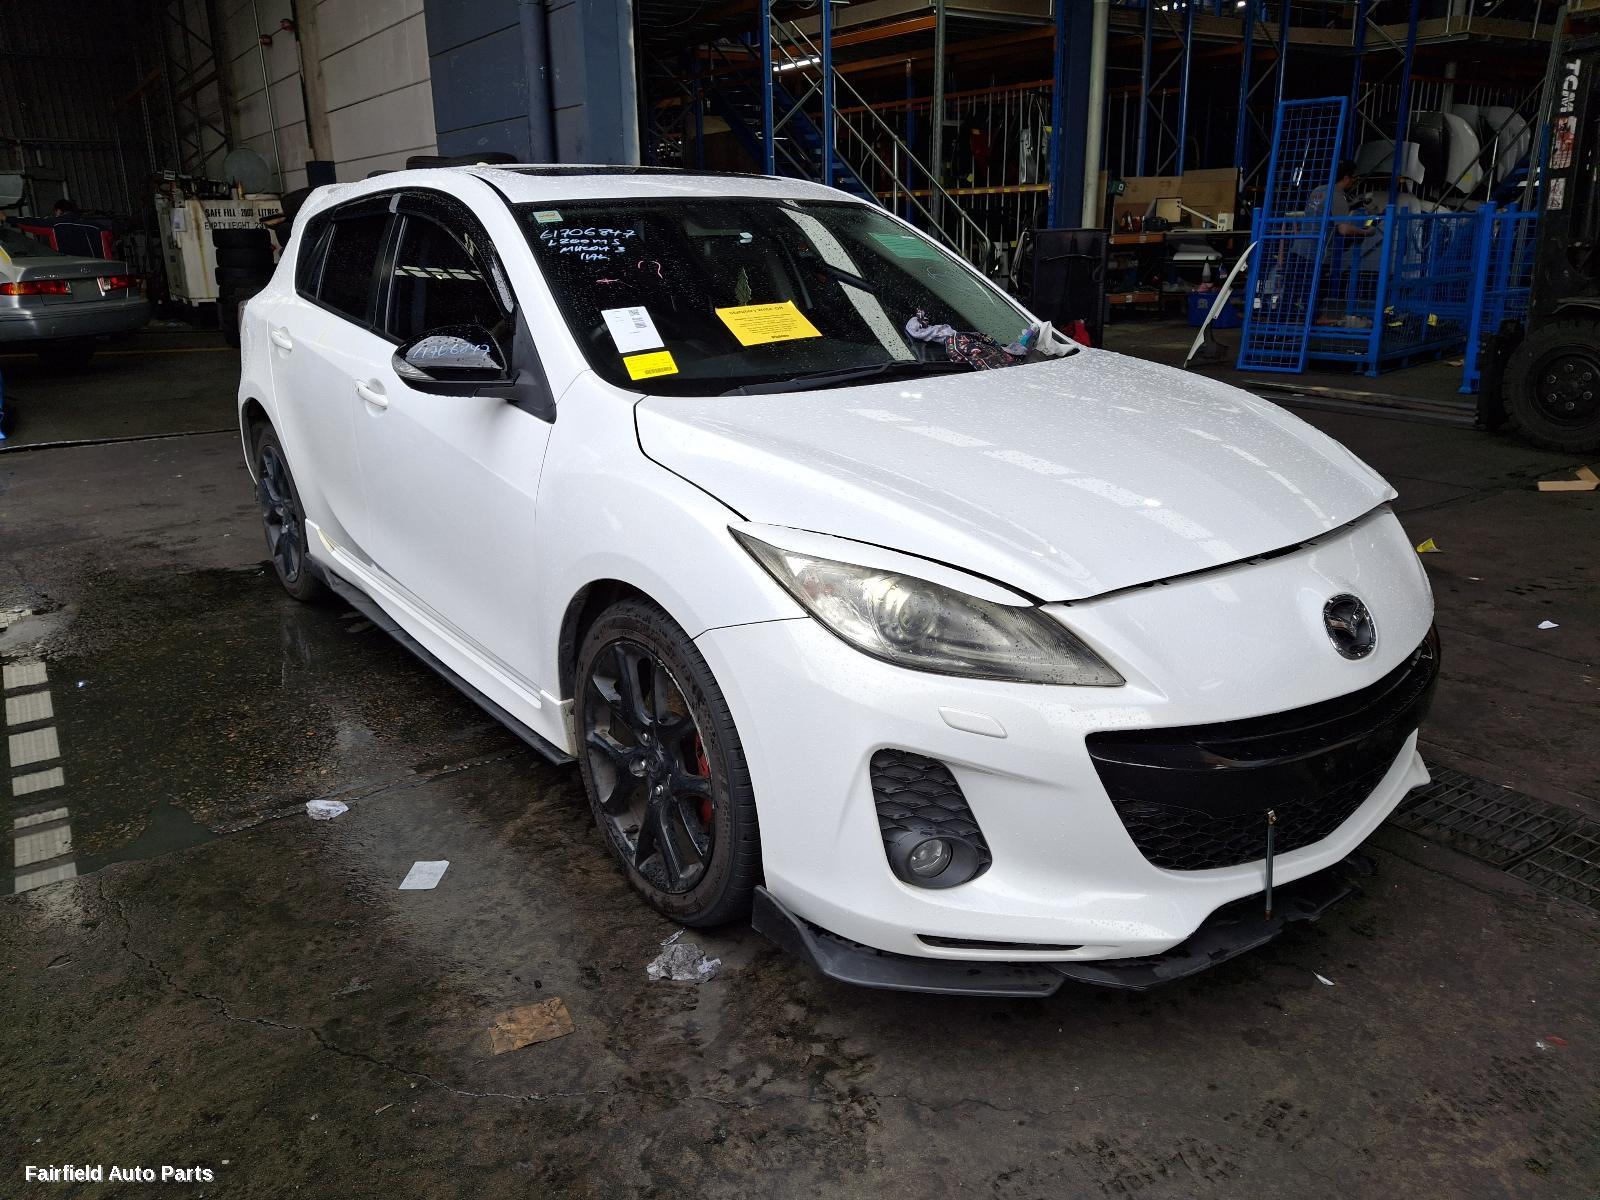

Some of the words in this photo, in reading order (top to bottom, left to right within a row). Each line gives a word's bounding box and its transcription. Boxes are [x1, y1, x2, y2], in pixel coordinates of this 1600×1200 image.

[1560, 58, 1581, 113] TCM
[205, 208, 221, 217] SAFE
[223, 208, 236, 217] FILL
